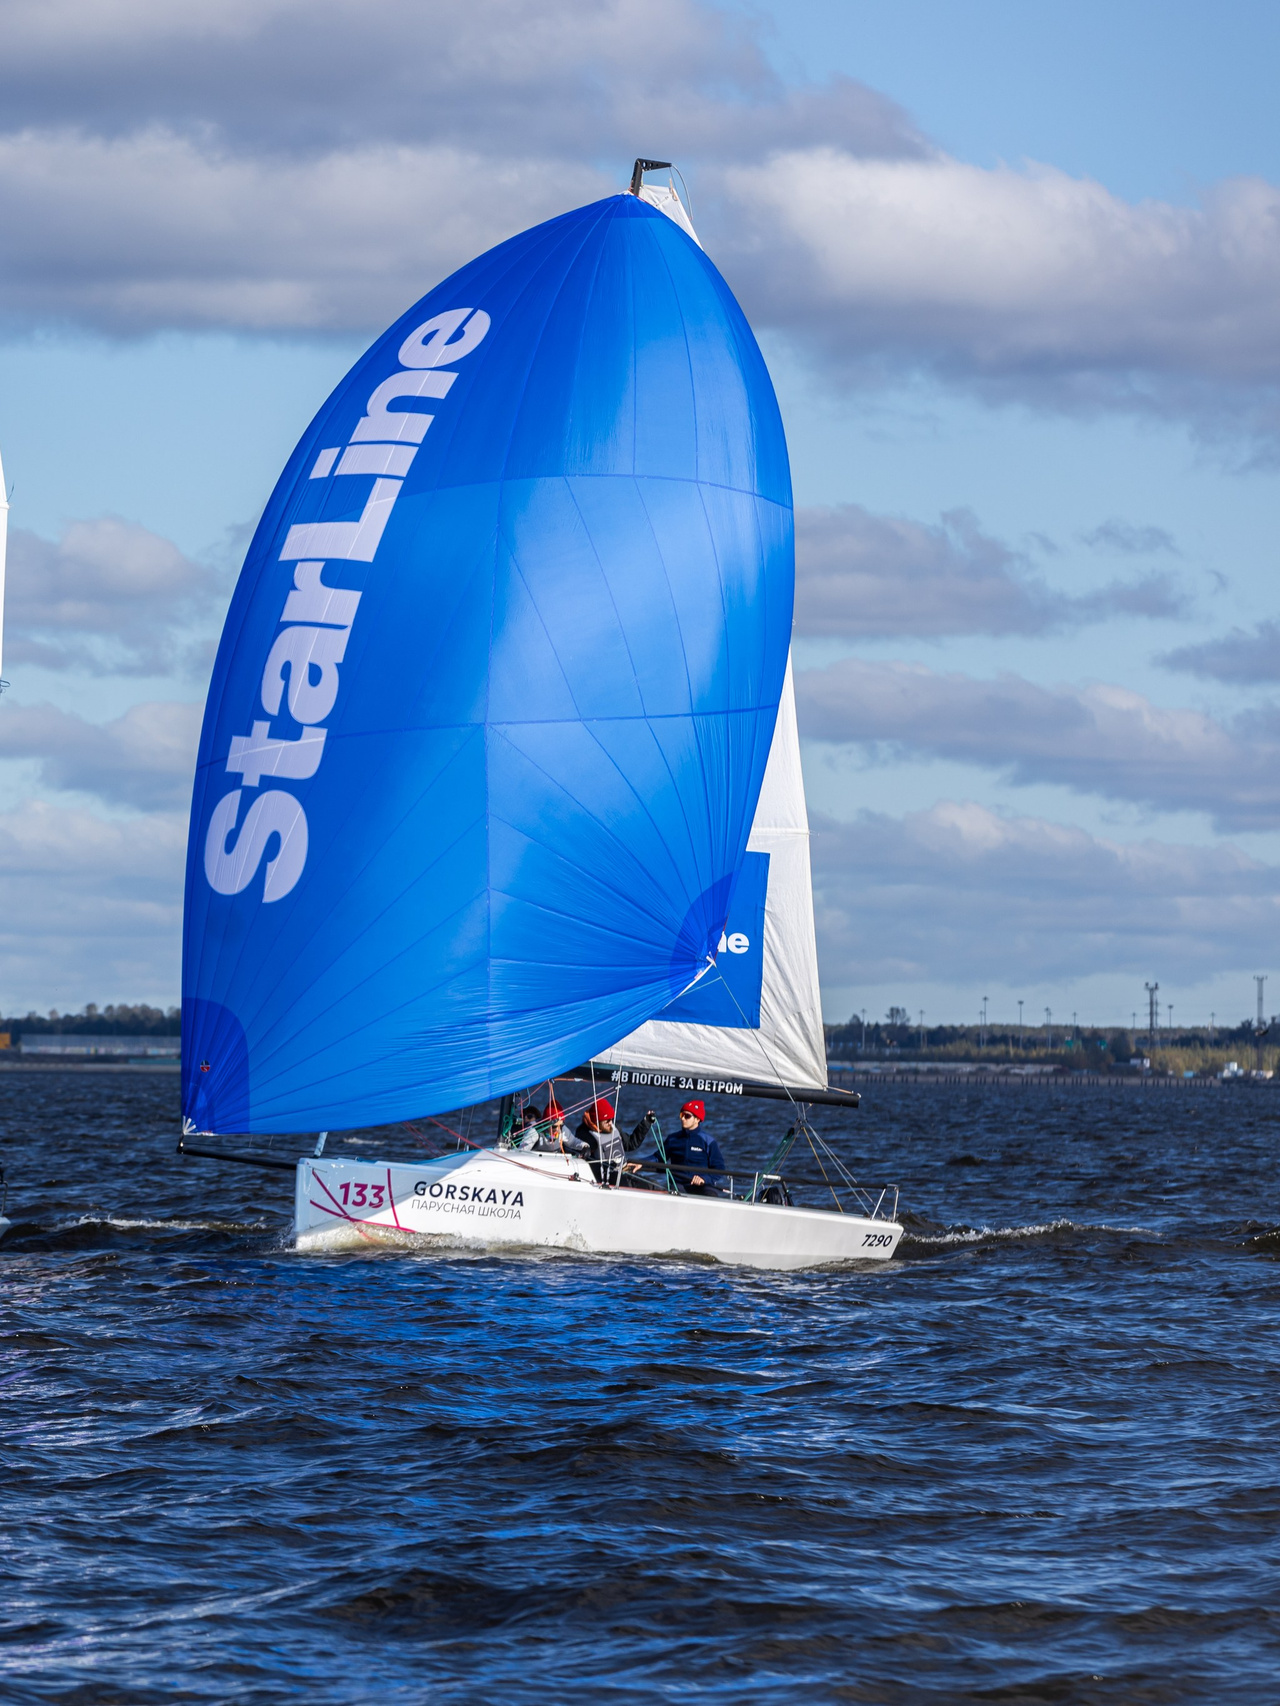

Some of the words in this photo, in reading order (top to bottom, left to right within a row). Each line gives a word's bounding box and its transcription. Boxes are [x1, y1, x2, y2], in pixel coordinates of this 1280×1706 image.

[204, 307, 492, 904] StarLine
[631, 1073, 676, 1088] ПОГОНЕ
[679, 1077, 694, 1090] ЗА
[697, 1080, 743, 1095] ВЕТРОМ
[339, 1182, 385, 1209] 133
[414, 1181, 524, 1208] GORSKAYA
[411, 1199, 475, 1215] ПАРУСНАЯ
[478, 1207, 522, 1220] ШКОЛА
[861, 1234, 893, 1248] 7290
